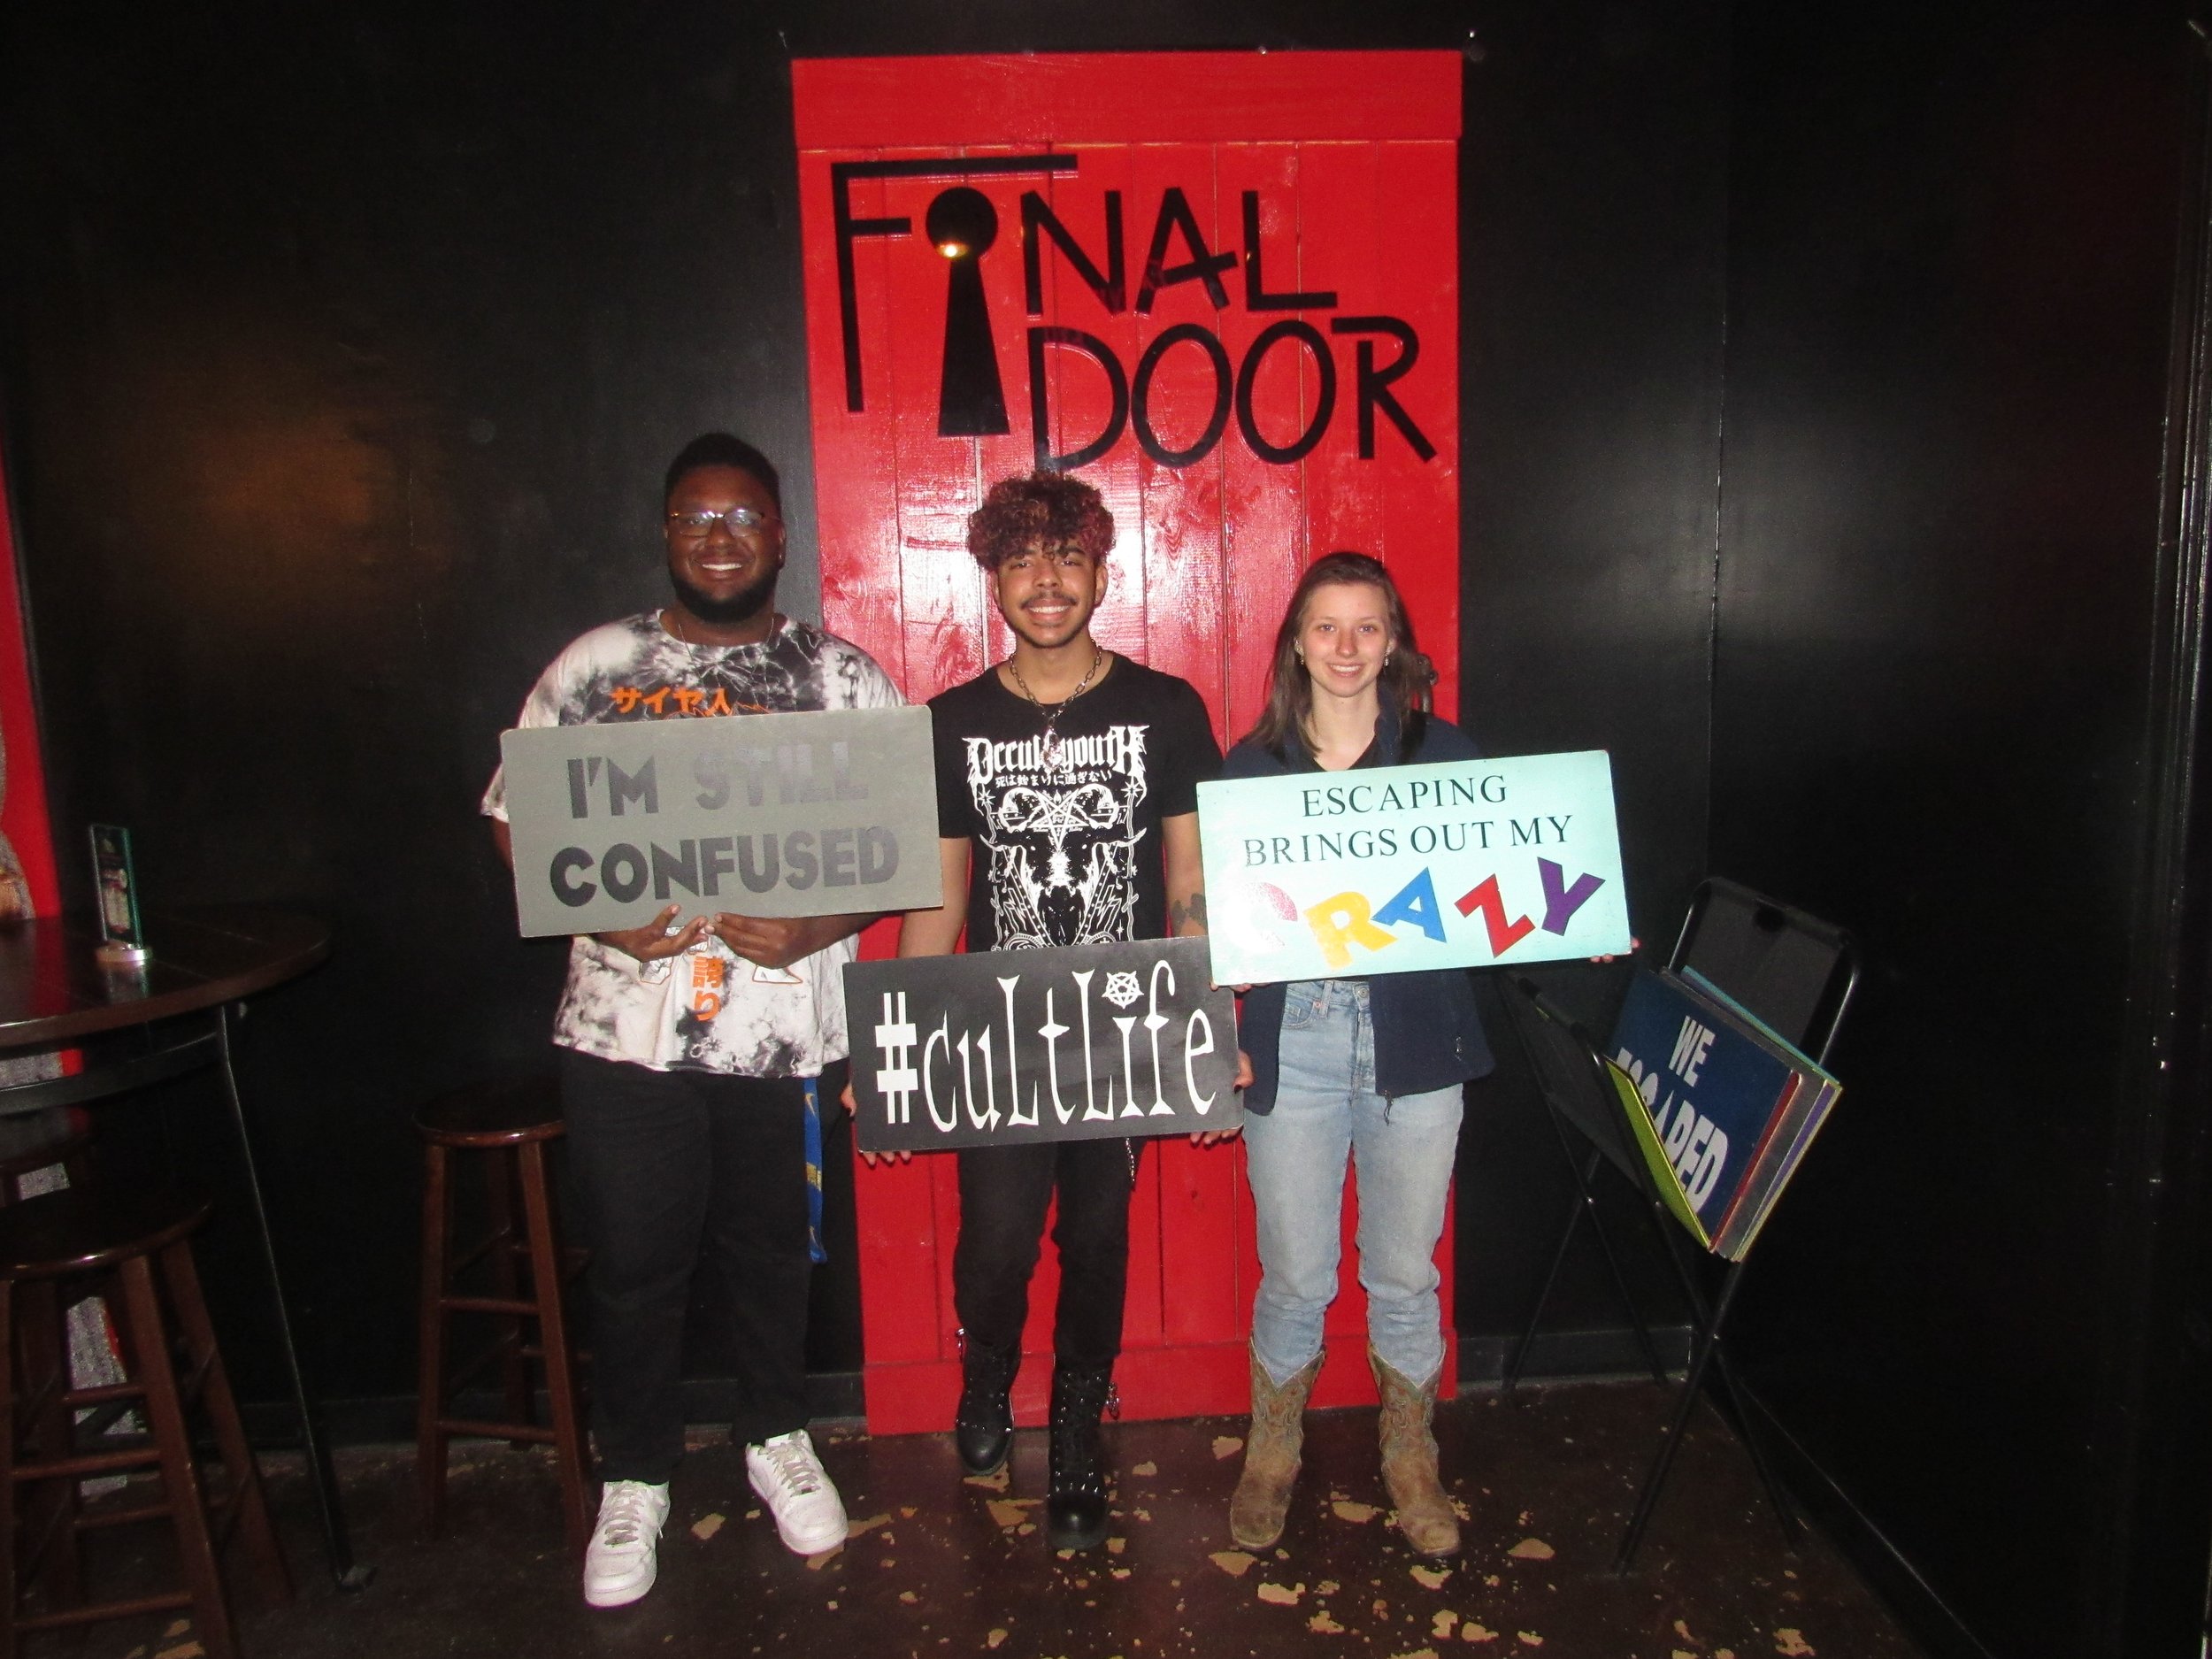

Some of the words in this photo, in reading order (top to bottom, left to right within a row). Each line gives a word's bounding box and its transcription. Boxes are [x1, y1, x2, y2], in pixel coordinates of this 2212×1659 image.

[1026, 316, 1437, 471] DOOR
[611, 687, 733, 717] サイヤ人
[566, 755, 658, 818] I'M
[693, 741, 869, 810] STILL
[1302, 775, 1506, 818] ESCAPING
[550, 826, 899, 908] CONFUSED
[1243, 828, 1398, 867] BRINGS
[1410, 821, 1495, 854] OUT
[1509, 815, 1573, 846] MY
[1669, 1015, 1716, 1087] WE
